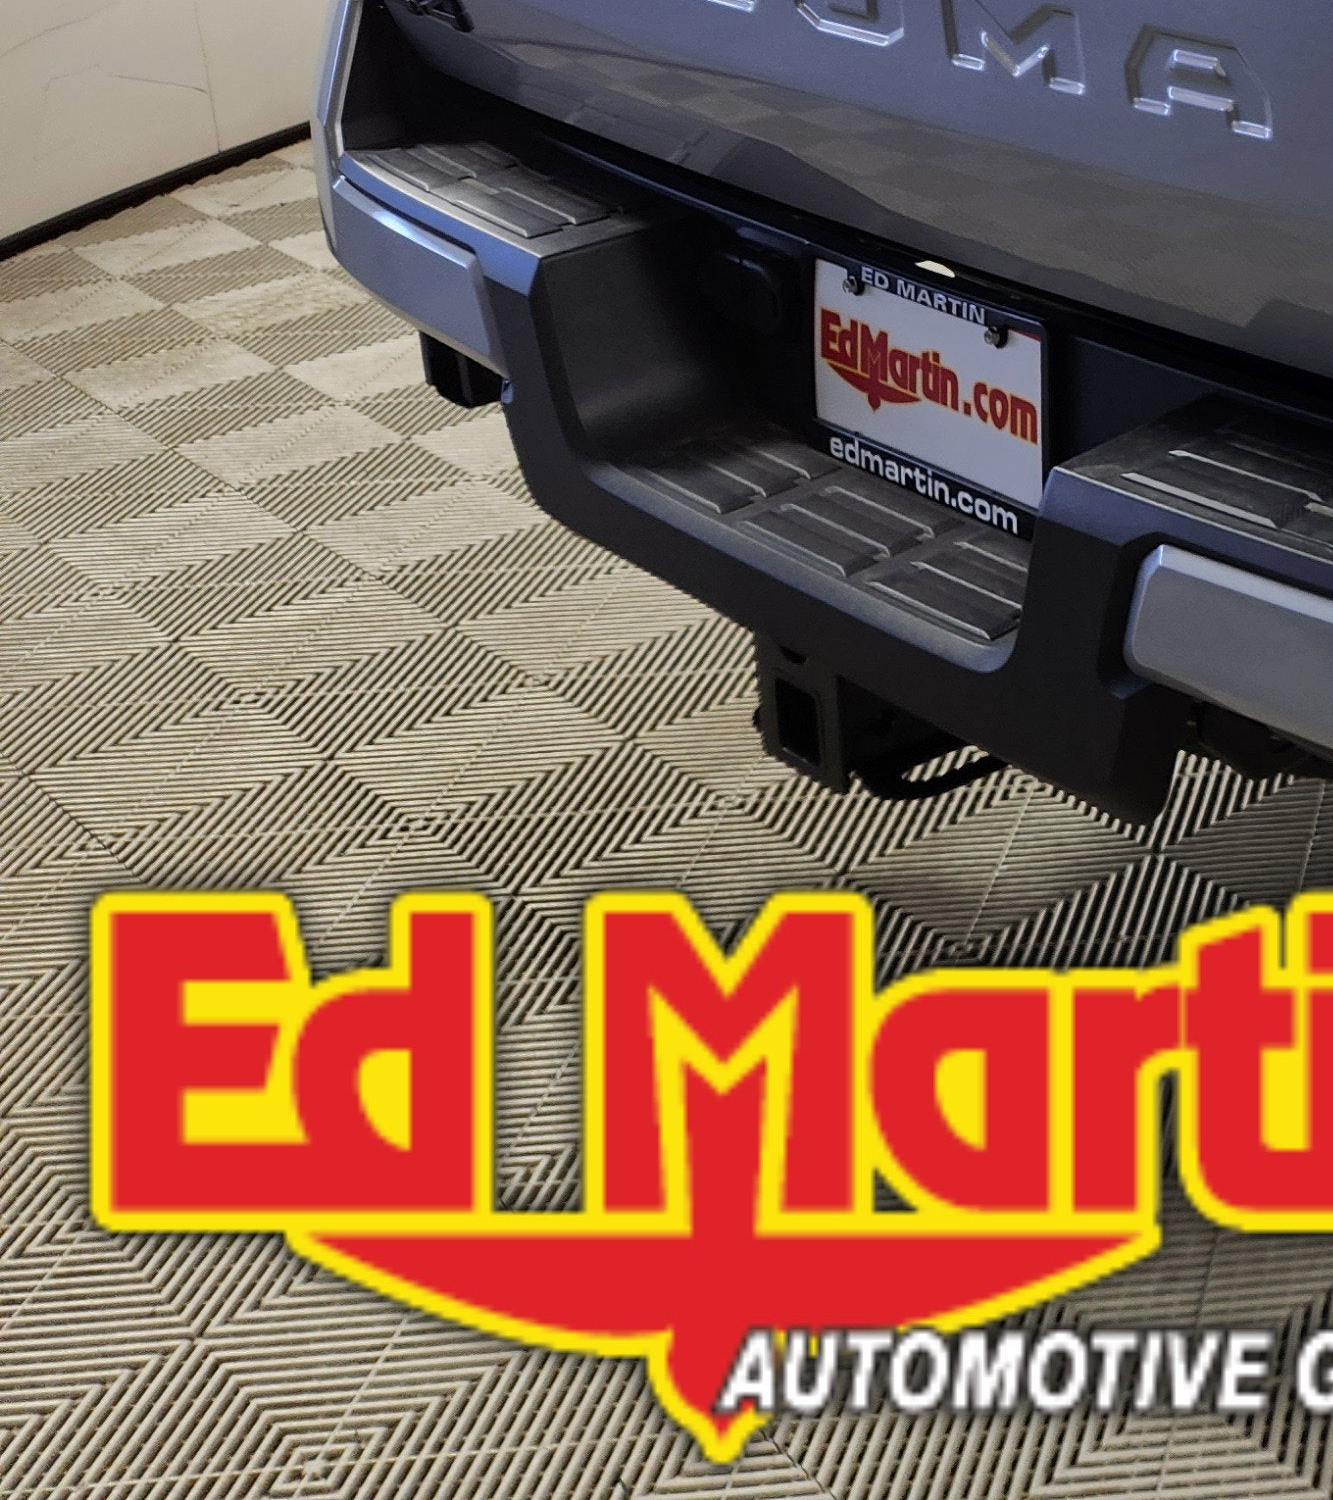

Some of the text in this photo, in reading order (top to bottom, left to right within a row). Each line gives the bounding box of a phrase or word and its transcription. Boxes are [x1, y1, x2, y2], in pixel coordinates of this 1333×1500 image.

[860, 265, 987, 326] ED MARTIN
[829, 436, 1020, 536] edmartin.com
